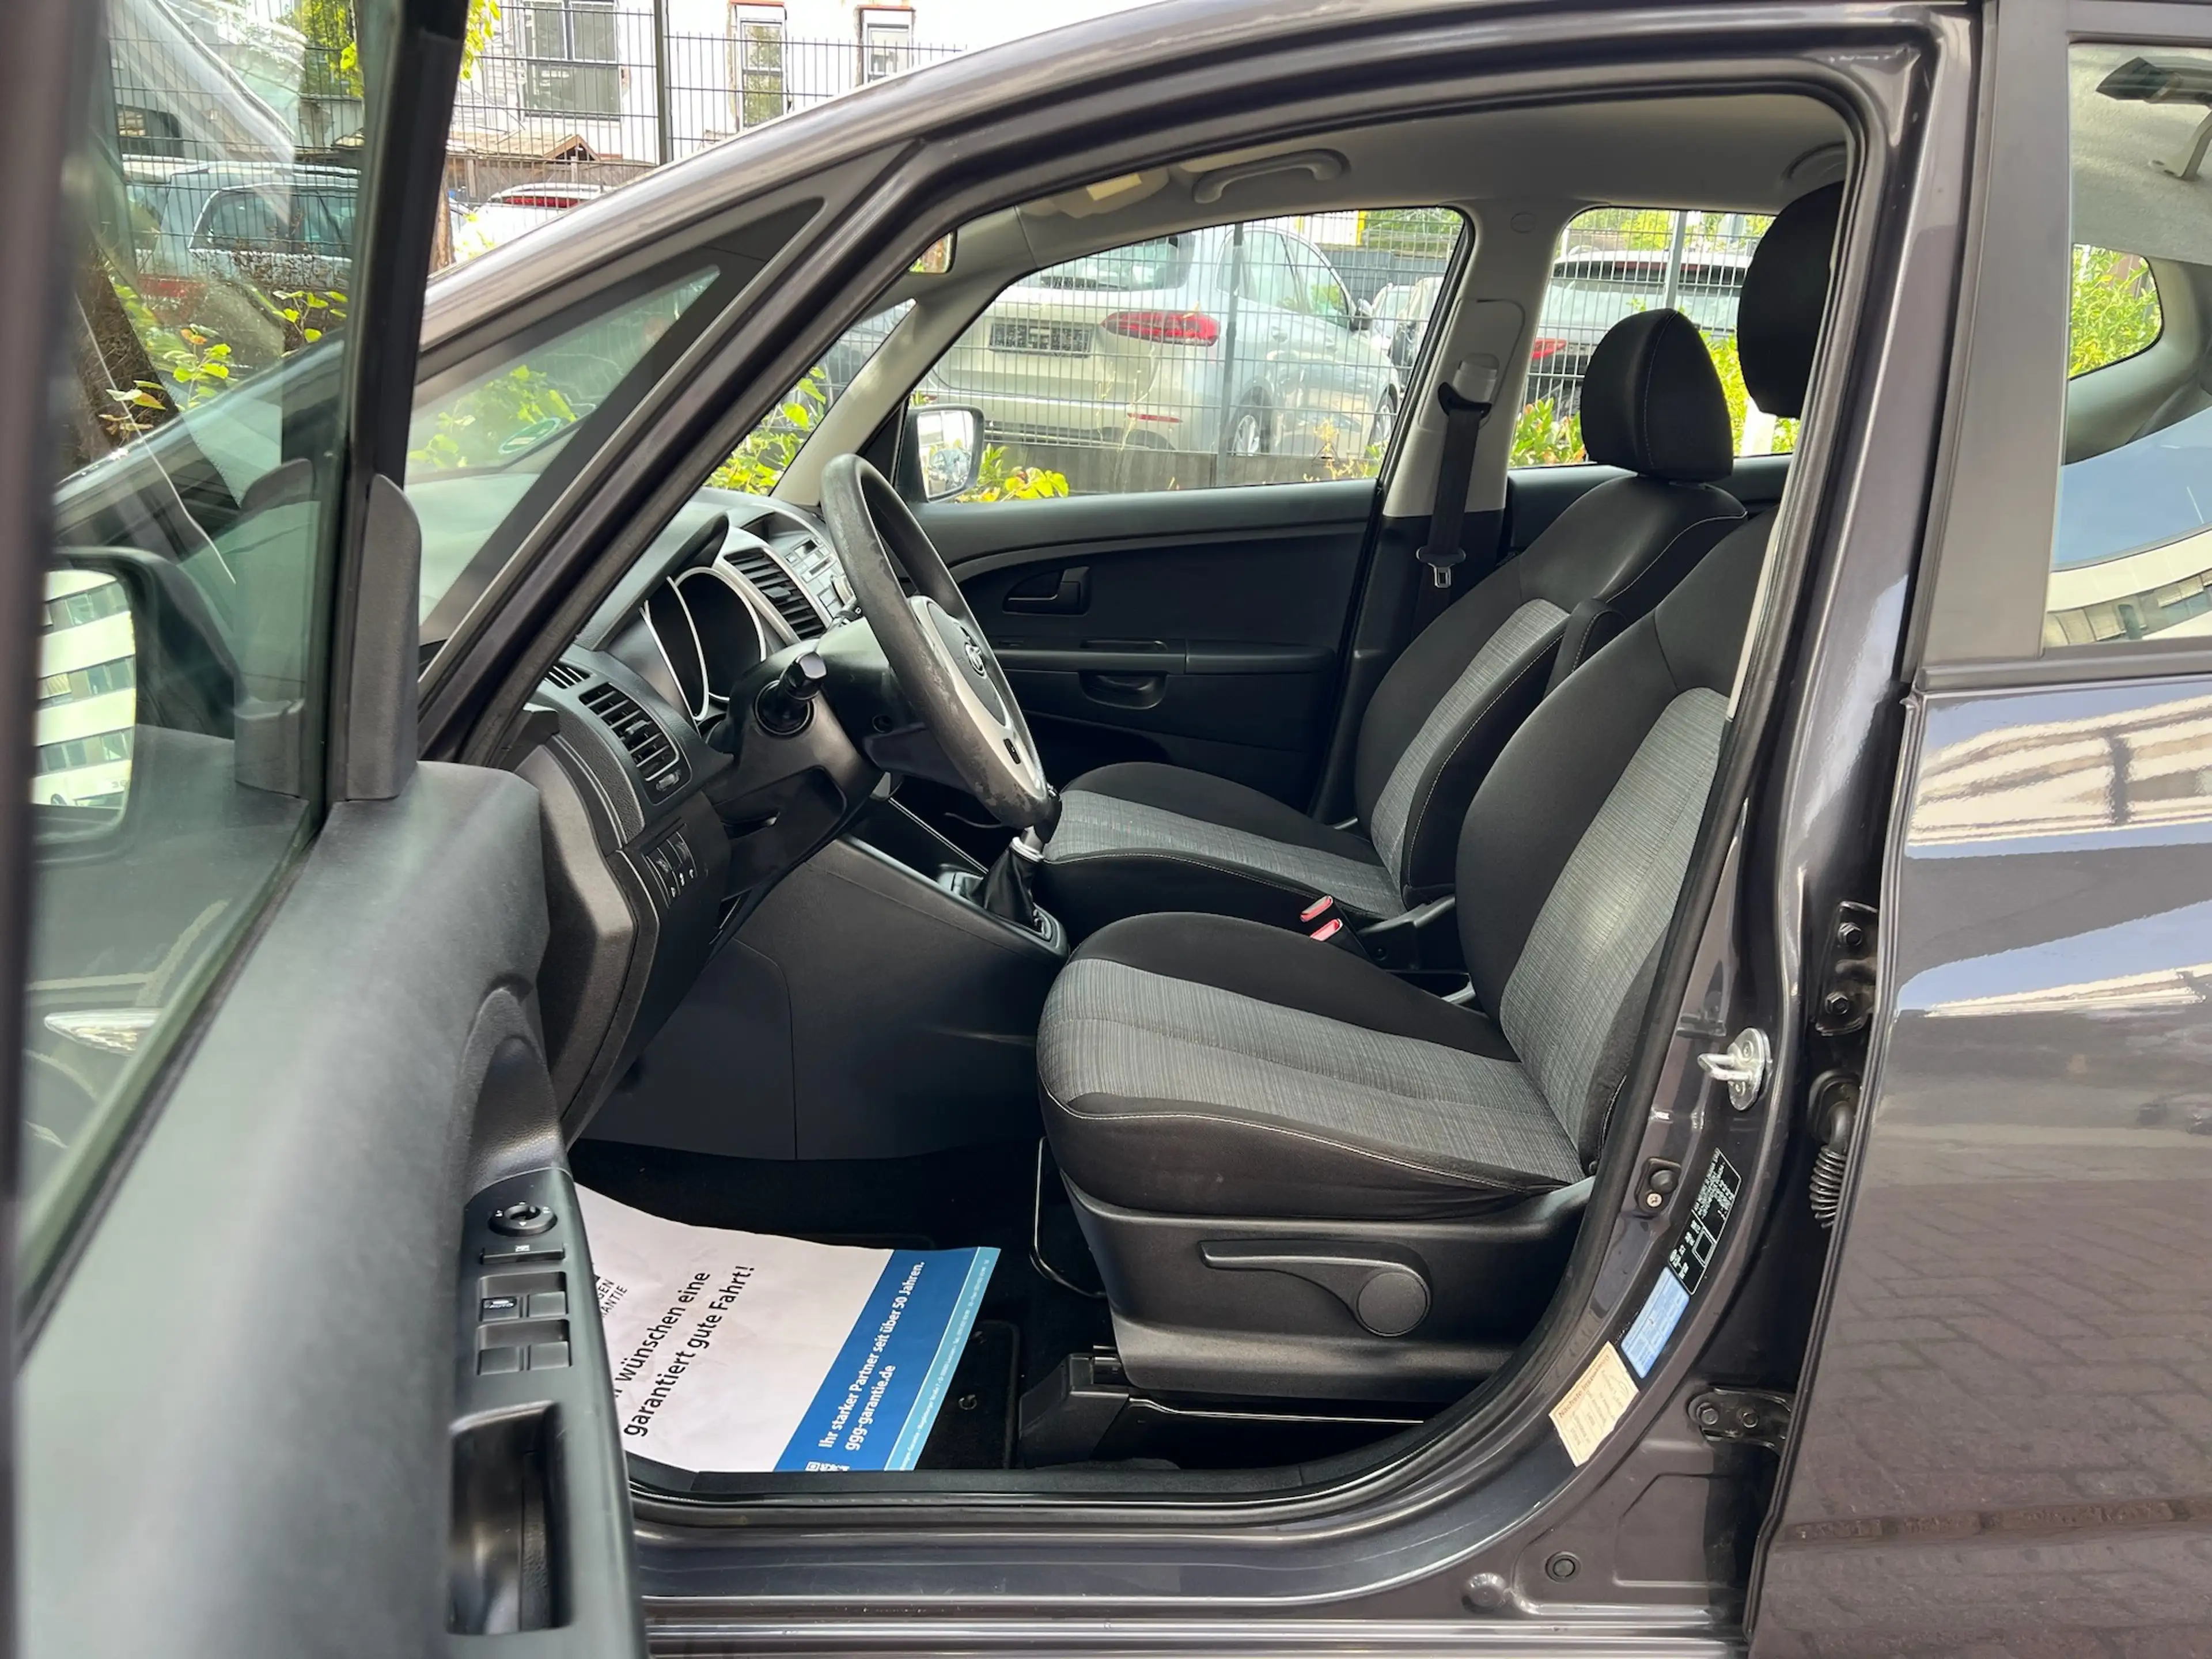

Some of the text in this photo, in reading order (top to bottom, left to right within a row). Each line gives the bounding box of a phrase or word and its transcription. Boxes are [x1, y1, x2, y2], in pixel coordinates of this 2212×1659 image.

[601, 1285, 628, 1318] ANTIE
[615, 1272, 710, 1381] wünschen eine
[624, 1266, 755, 1437] garantiert gute Fahrt!
[818, 1262, 925, 1448] Ihr starker Partner seit über 50 Jahren.
[845, 1365, 896, 1450] ggg-garantie.de
